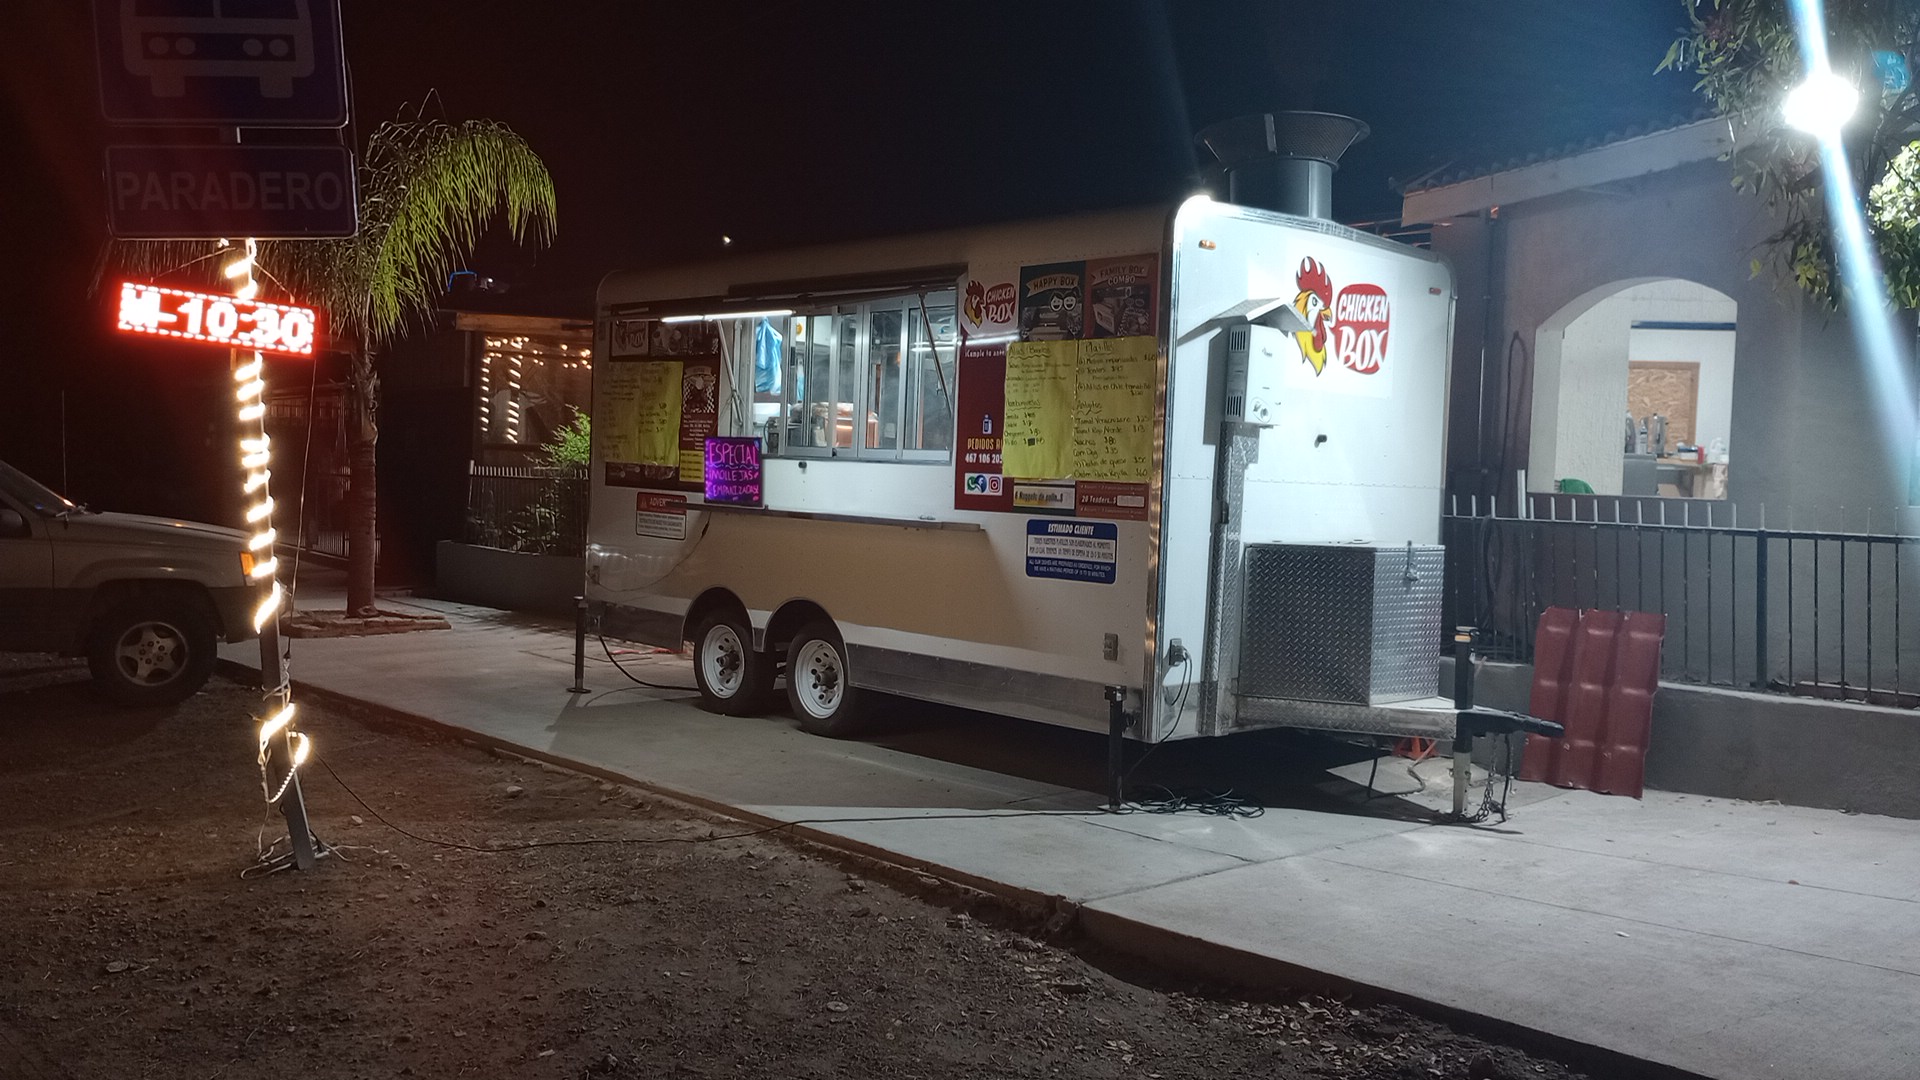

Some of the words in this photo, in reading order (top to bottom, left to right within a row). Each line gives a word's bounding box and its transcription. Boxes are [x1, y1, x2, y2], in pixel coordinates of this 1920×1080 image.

[115, 171, 342, 211] PARADERO
[1100, 266, 1126, 278] FAMILY
[1128, 264, 1145, 274] BOX
[1033, 277, 1056, 292] HAPPY
[1060, 275, 1076, 286] BOX
[1108, 275, 1136, 286] COMBO
[987, 285, 1015, 303] CHICKEN
[988, 302, 1015, 323] BOX
[1338, 294, 1389, 322] CHICKEN
[1338, 325, 1389, 370] BOX
[967, 438, 994, 450] PEDIDOS
[710, 442, 760, 466] ESPECIAL
[964, 452, 978, 464] 467
[978, 453, 990, 464] 106
[1048, 524, 1074, 534] ESTIMADO
[1074, 525, 1094, 536] CLIENTE
